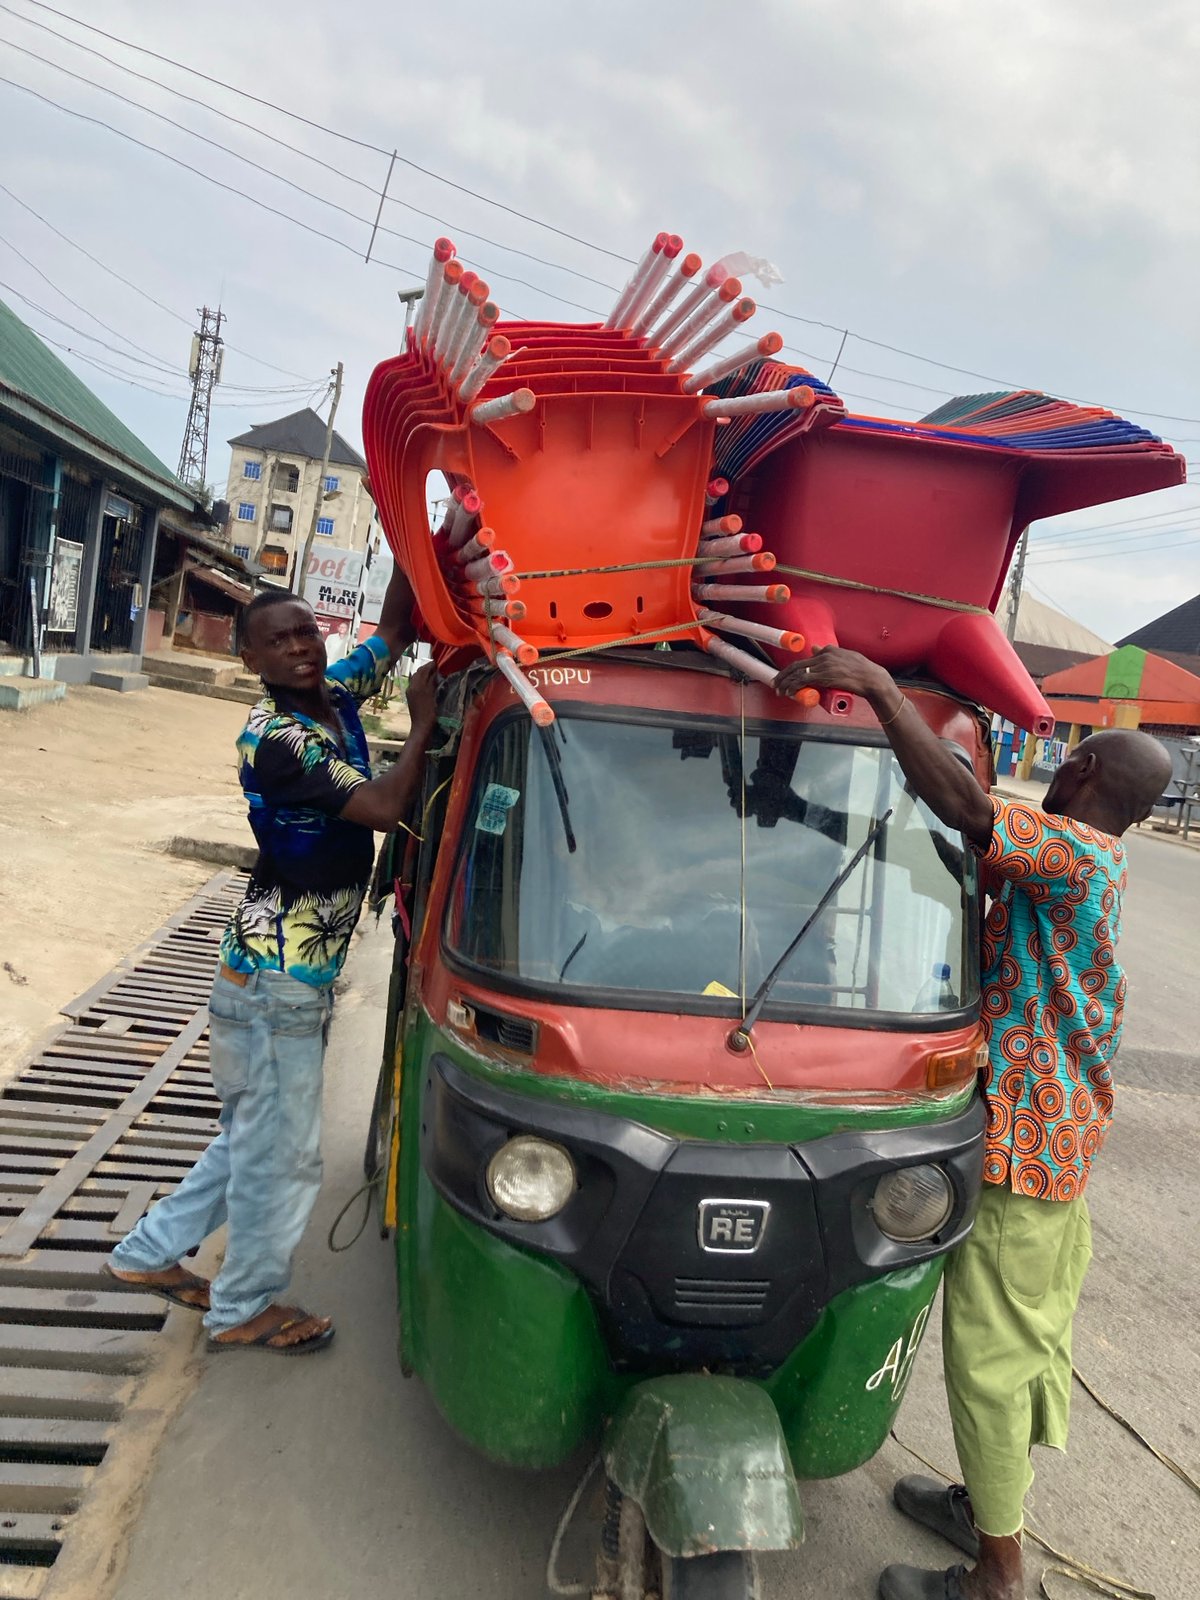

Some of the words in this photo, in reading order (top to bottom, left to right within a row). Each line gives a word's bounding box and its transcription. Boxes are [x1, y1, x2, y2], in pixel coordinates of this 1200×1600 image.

[318, 593, 356, 607] THAN
[510, 667, 591, 694] STOPU
[710, 1217, 755, 1241] RE
